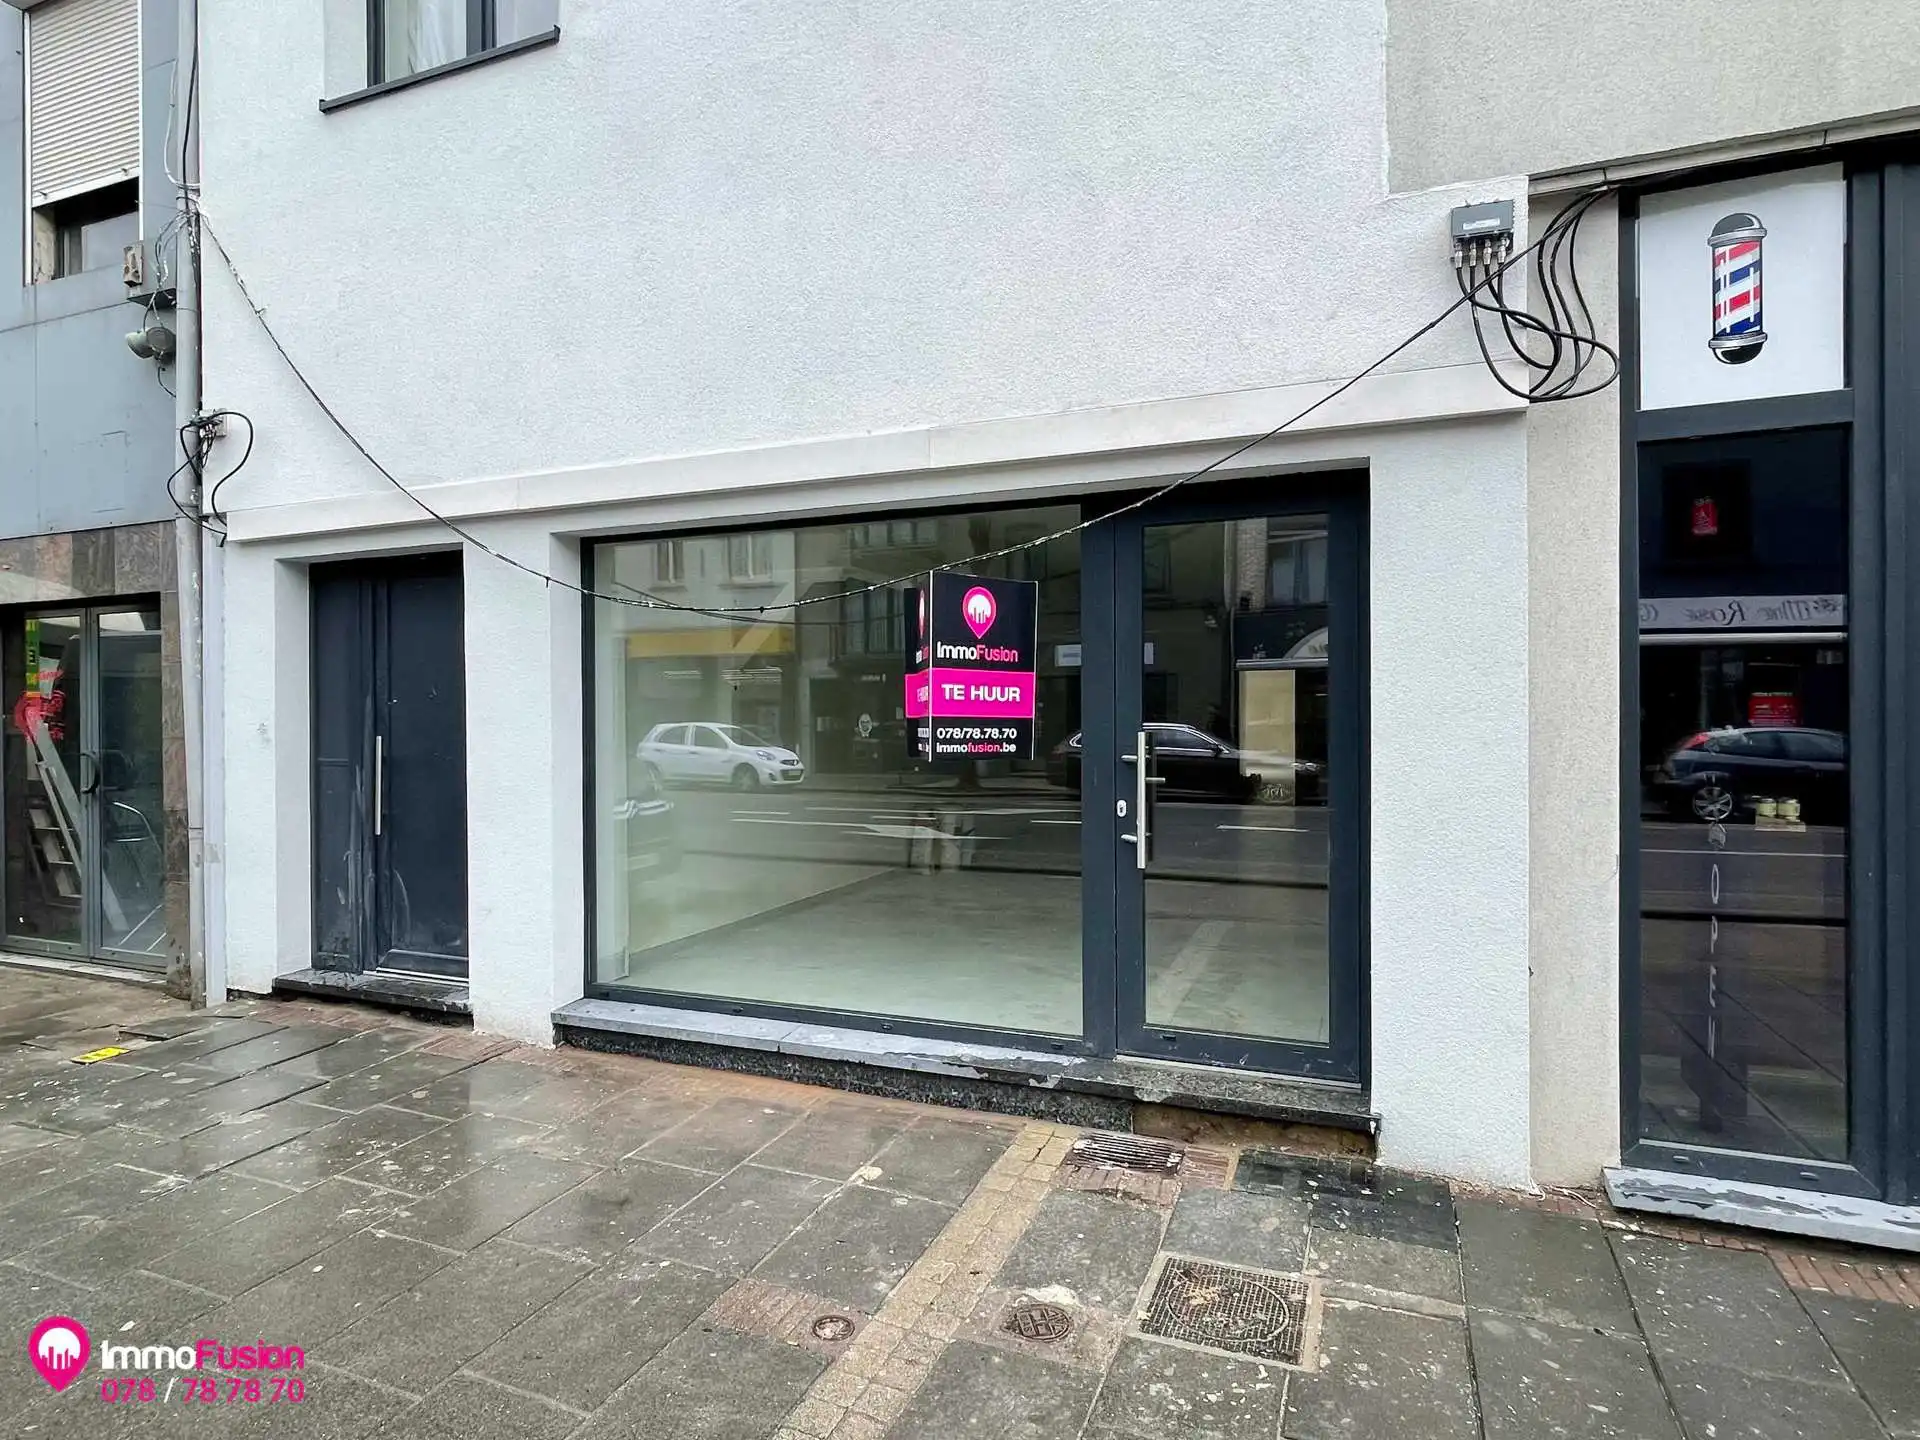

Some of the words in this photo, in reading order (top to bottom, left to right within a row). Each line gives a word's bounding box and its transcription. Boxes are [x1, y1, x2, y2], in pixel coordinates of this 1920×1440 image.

[936, 641, 1018, 662] ImmoFusion
[941, 684, 966, 701] TE
[970, 685, 1021, 702] HUUR
[936, 727, 1018, 740] 078/78.78.70
